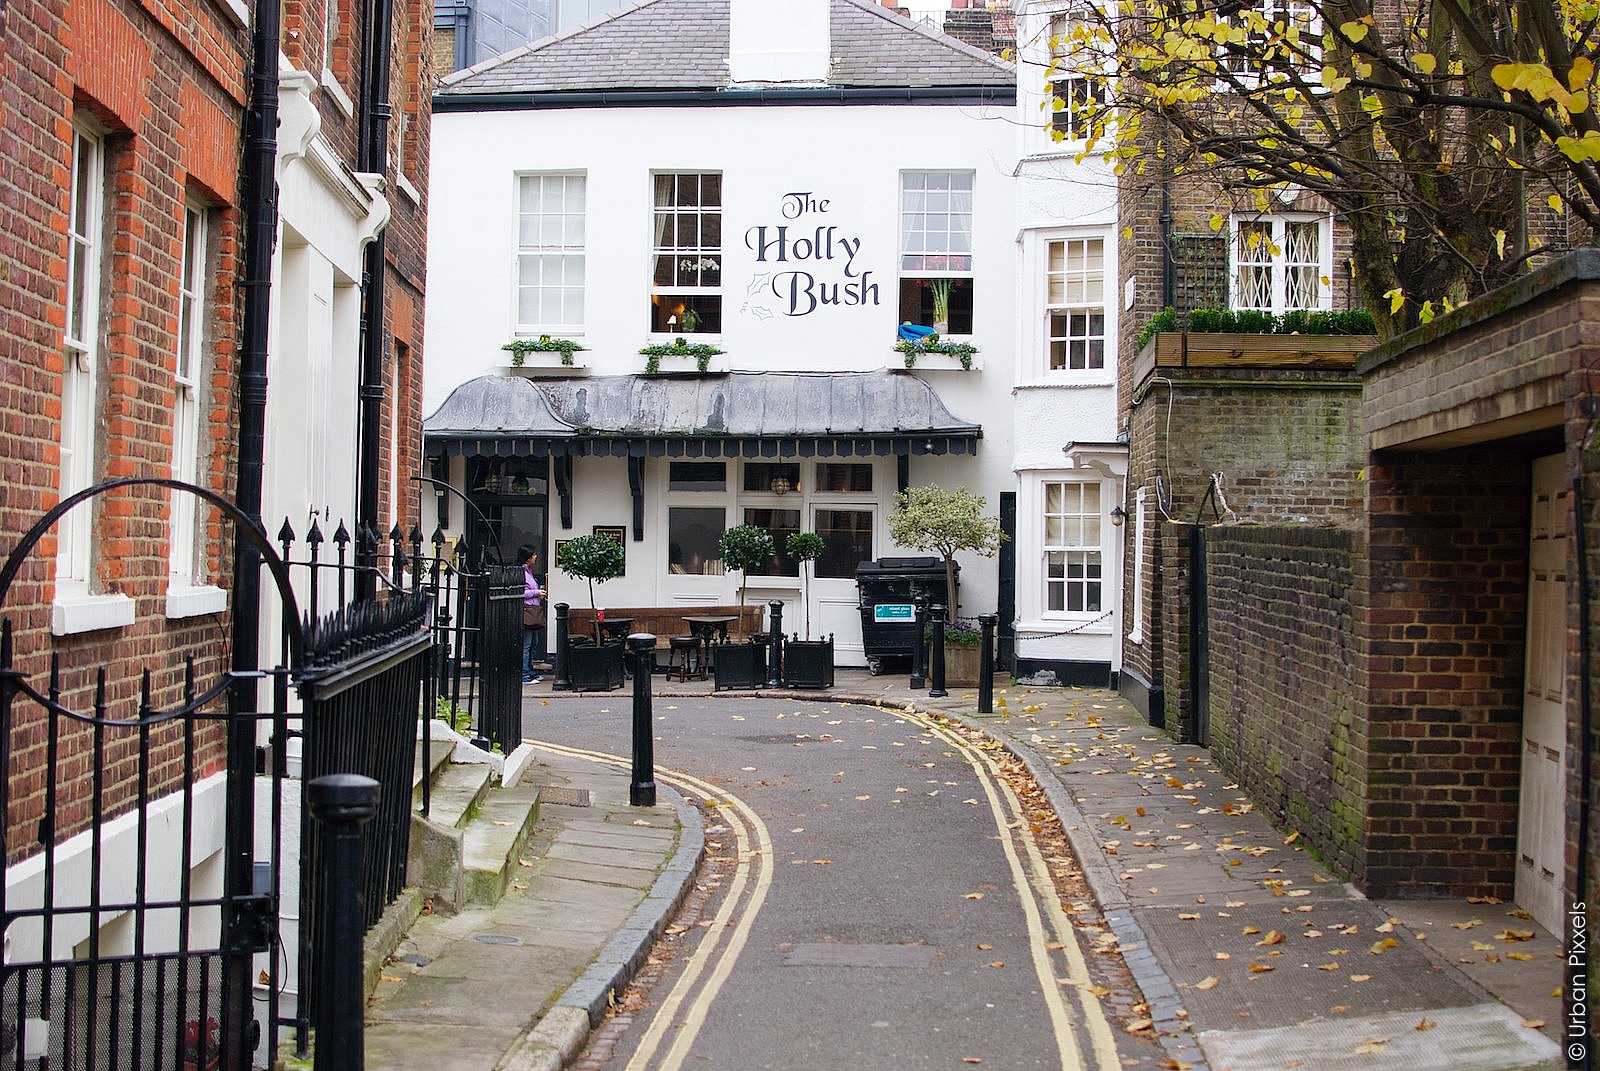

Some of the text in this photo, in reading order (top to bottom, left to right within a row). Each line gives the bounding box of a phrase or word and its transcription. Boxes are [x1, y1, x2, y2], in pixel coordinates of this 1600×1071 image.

[781, 191, 831, 219] The
[744, 225, 861, 278] Holly
[771, 271, 880, 316] Bush
